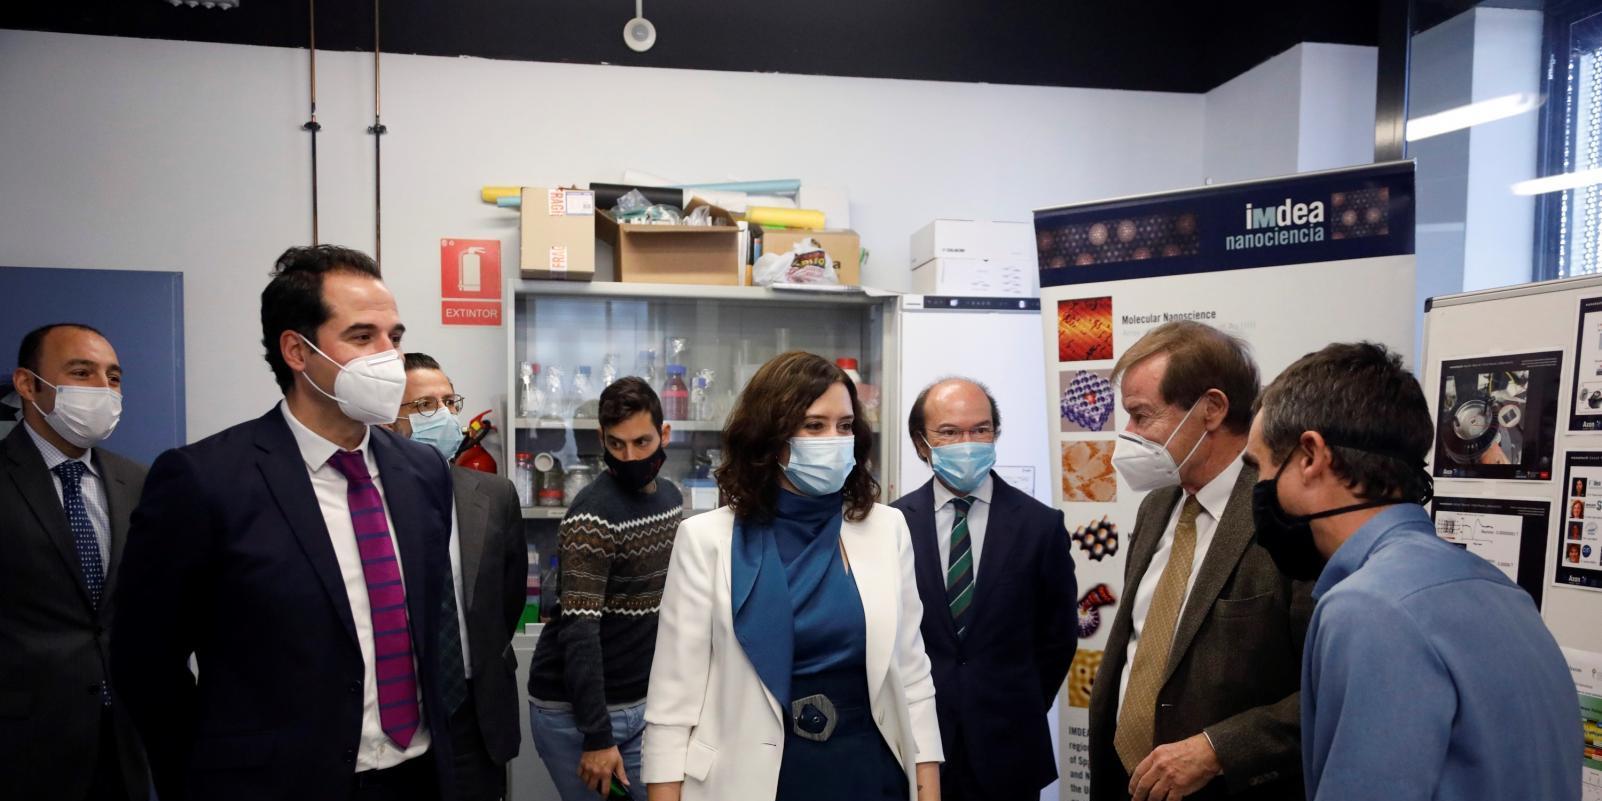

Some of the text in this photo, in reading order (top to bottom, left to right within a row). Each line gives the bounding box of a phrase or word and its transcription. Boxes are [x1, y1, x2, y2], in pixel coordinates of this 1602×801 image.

[1226, 224, 1324, 250] nanociencia
[446, 308, 497, 318] EXTINTOR
[1121, 309, 1216, 325] Molecular Nanoscience
[1069, 743, 1089, 752] regio
[1078, 756, 1089, 767] Sp
[1070, 784, 1082, 793] the
